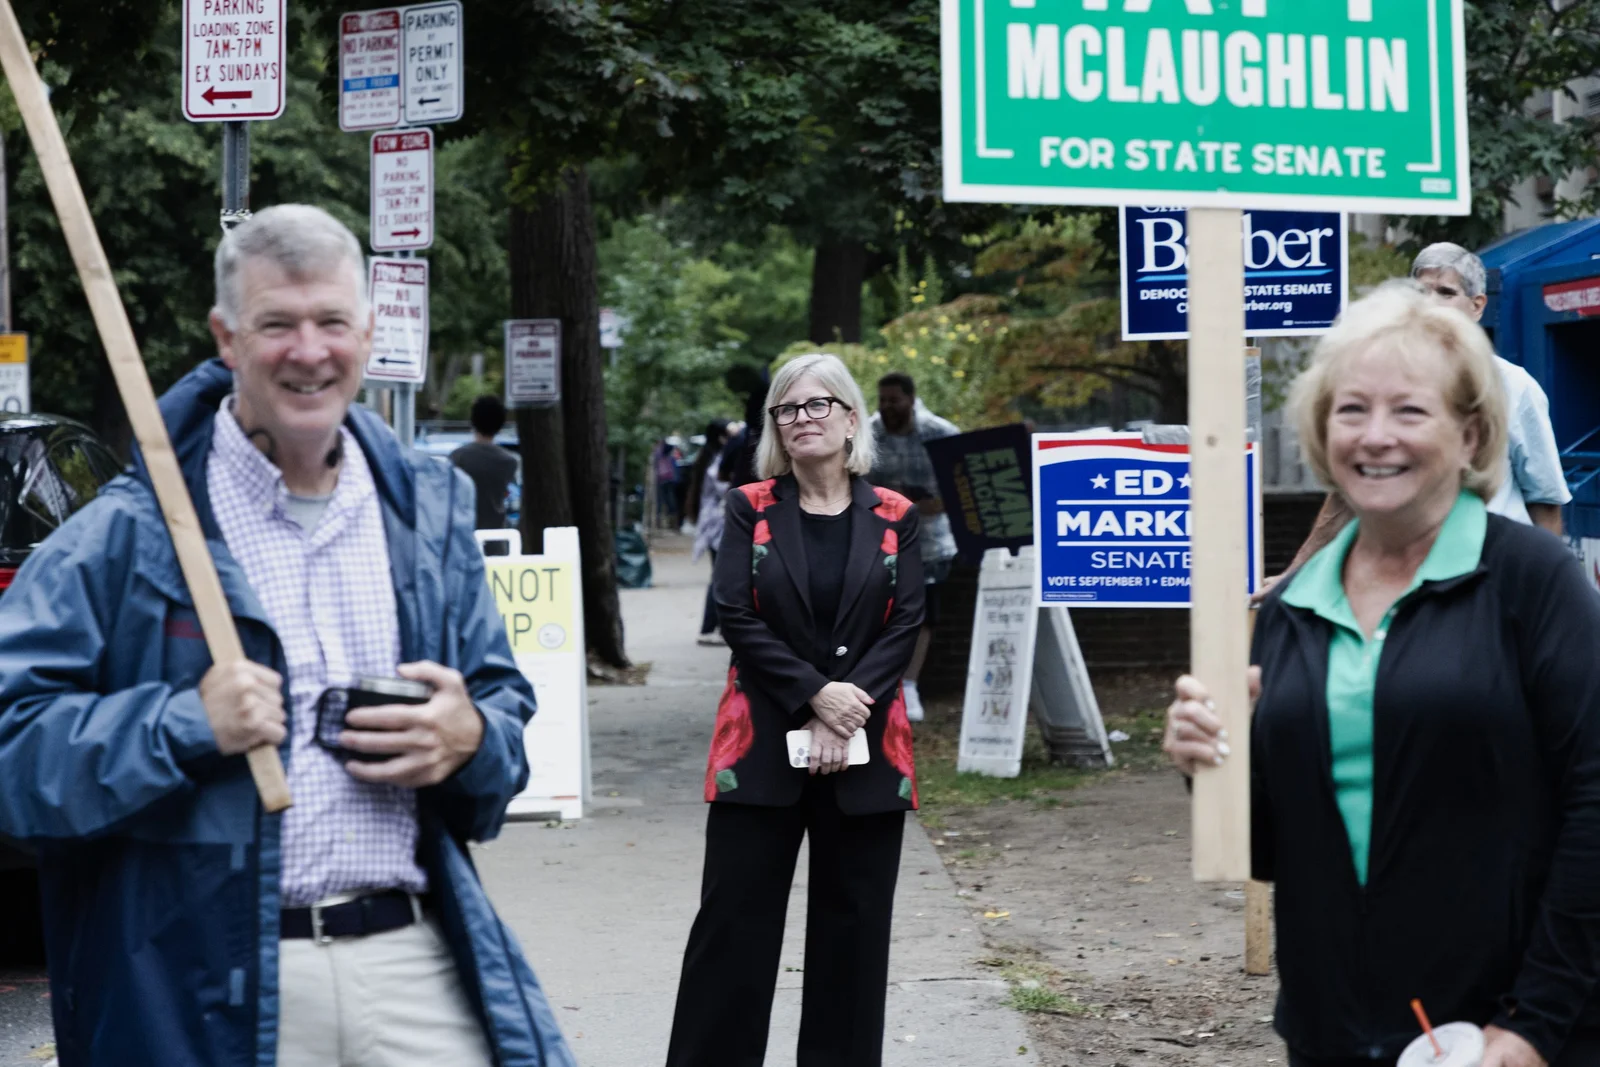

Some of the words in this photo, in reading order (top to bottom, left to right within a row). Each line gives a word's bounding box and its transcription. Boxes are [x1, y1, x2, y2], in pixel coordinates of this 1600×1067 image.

[204, 0, 264, 16] PARKING
[193, 22, 240, 37] LOADING
[246, 20, 274, 35] ZONE
[407, 11, 456, 31] PARKING
[206, 38, 262, 58] 7AM-7PM
[343, 39, 357, 54] NO
[359, 35, 399, 52] PARKING
[409, 42, 454, 63] PERMIT
[195, 65, 210, 82] EX
[219, 62, 278, 81] SUNDAYS
[416, 64, 448, 82] ONLY
[1006, 22, 1409, 113] MCLAUGHLIN
[377, 136, 398, 151] TOW
[400, 133, 427, 150] ZONE
[396, 156, 408, 168] NO
[1040, 136, 1114, 170] FOR
[1124, 140, 1242, 174] STATE
[1252, 143, 1386, 179] SENATE
[383, 170, 421, 184] PARKING
[1135, 213, 1334, 273] Bber
[395, 288, 410, 301] NO
[1140, 287, 1189, 300] DEMOC
[1243, 284, 1282, 297] STATE
[1282, 282, 1333, 296] SENATE
[378, 303, 421, 319] PARKING
[1115, 469, 1174, 496] ED
[984, 448, 1033, 537] EVAN
[1057, 510, 1191, 537] MARK
[492, 568, 560, 603] NOT
[1047, 576, 1077, 587] VOTE
[1078, 576, 1143, 587] SEPTEMBER
[1144, 577, 1150, 587] 1
